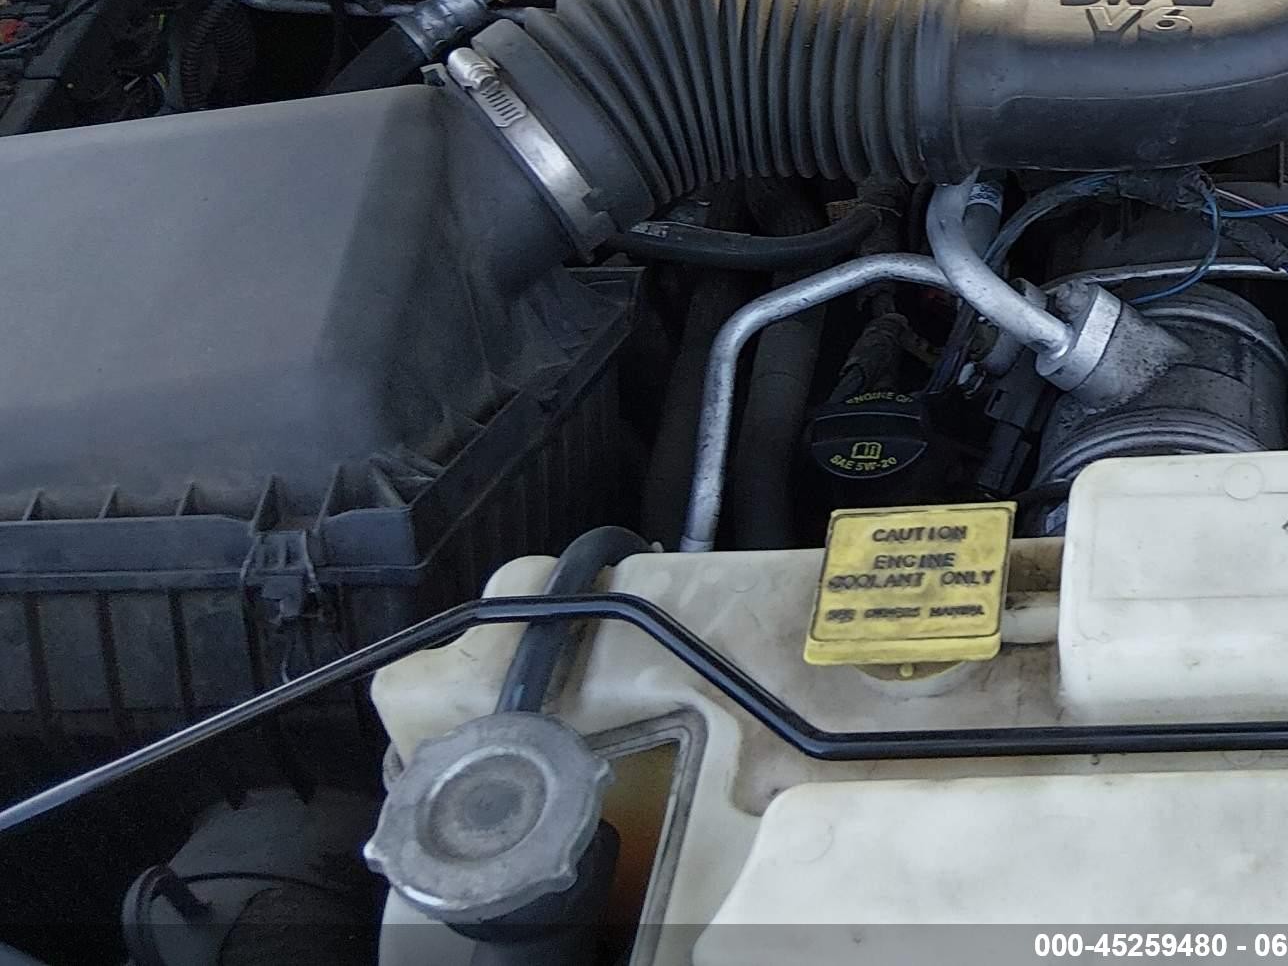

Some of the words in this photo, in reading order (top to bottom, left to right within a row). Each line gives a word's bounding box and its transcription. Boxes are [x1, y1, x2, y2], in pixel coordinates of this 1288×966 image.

[1085, 6, 1193, 38] V6
[829, 454, 855, 470] SAE
[855, 456, 898, 471] 5W-20
[871, 525, 968, 543] CAUTION
[873, 552, 956, 570] ENGINE
[828, 571, 926, 593] COOLANT
[940, 570, 996, 587] ONLY
